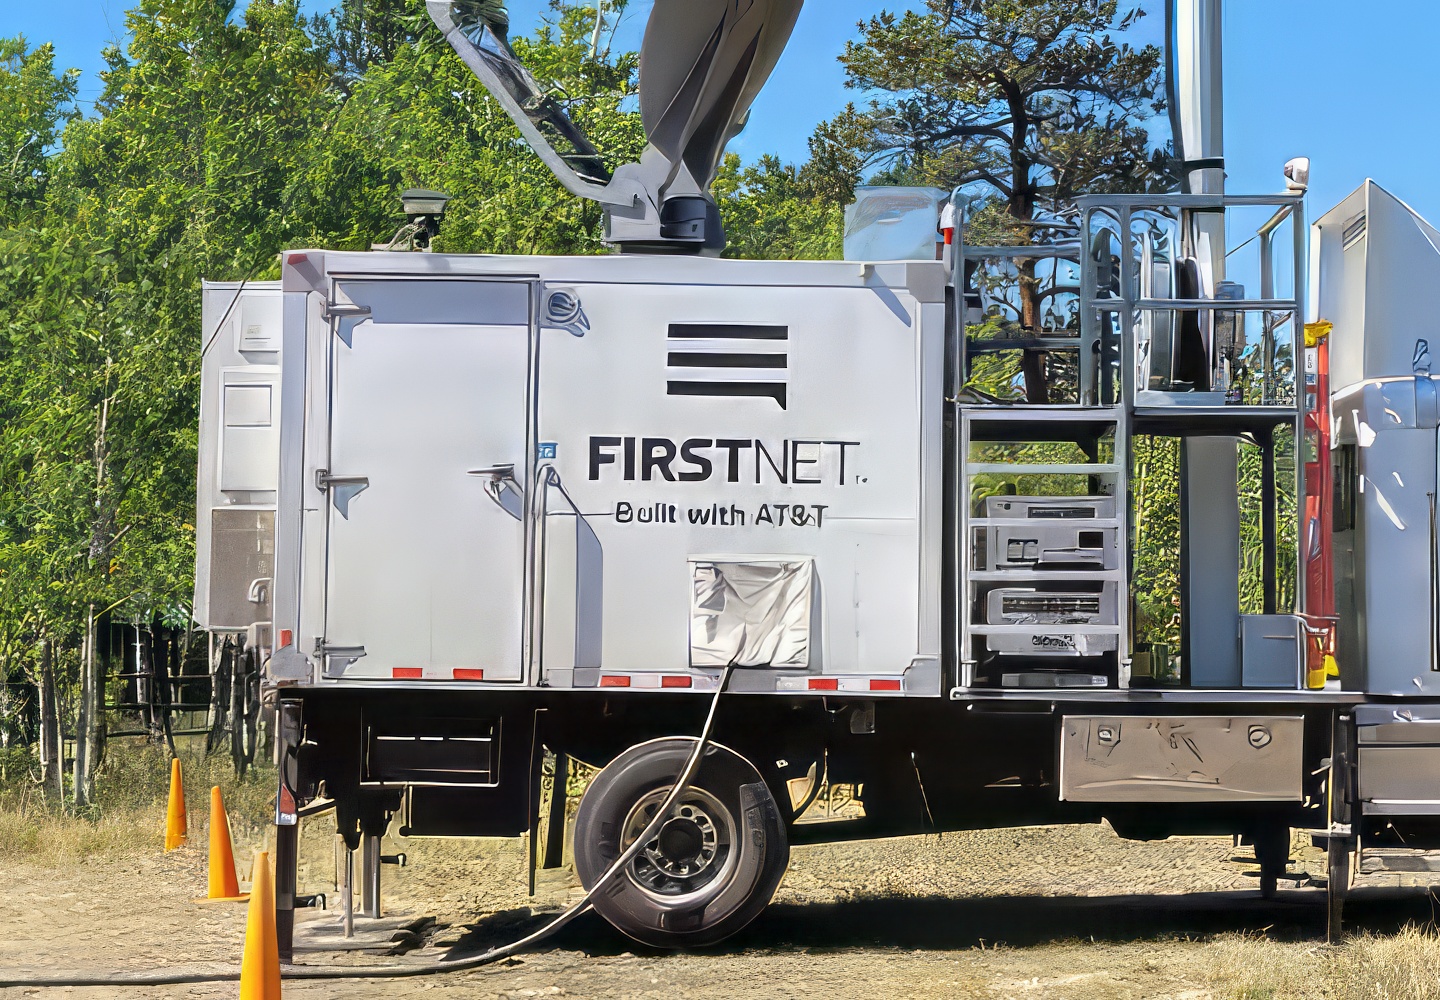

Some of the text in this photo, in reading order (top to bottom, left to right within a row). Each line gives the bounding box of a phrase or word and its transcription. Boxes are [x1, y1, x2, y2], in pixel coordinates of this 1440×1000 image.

[588, 436, 861, 485] FIRSTNET
[615, 501, 829, 528] Built with AT&T
